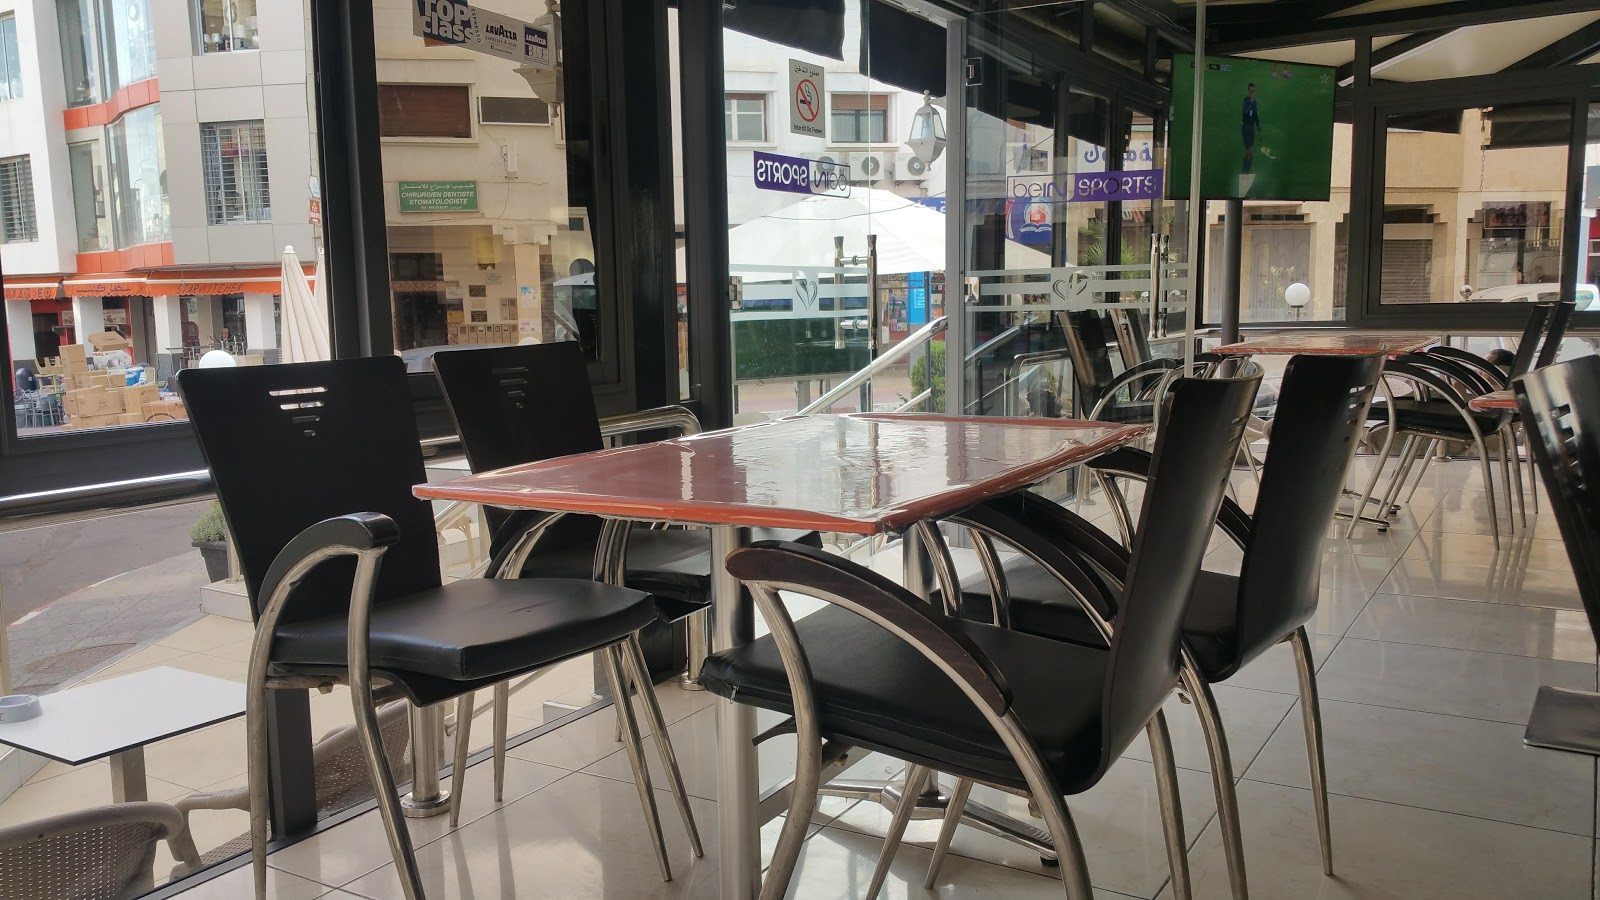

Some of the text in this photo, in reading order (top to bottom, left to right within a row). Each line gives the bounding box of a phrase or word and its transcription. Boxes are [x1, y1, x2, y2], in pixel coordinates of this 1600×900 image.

[422, 0, 471, 25] TOP
[419, 11, 475, 43] class
[485, 24, 518, 41] LAVAZZA
[526, 33, 547, 46] LAVAZZA
[1078, 175, 1157, 196] SPORTS
